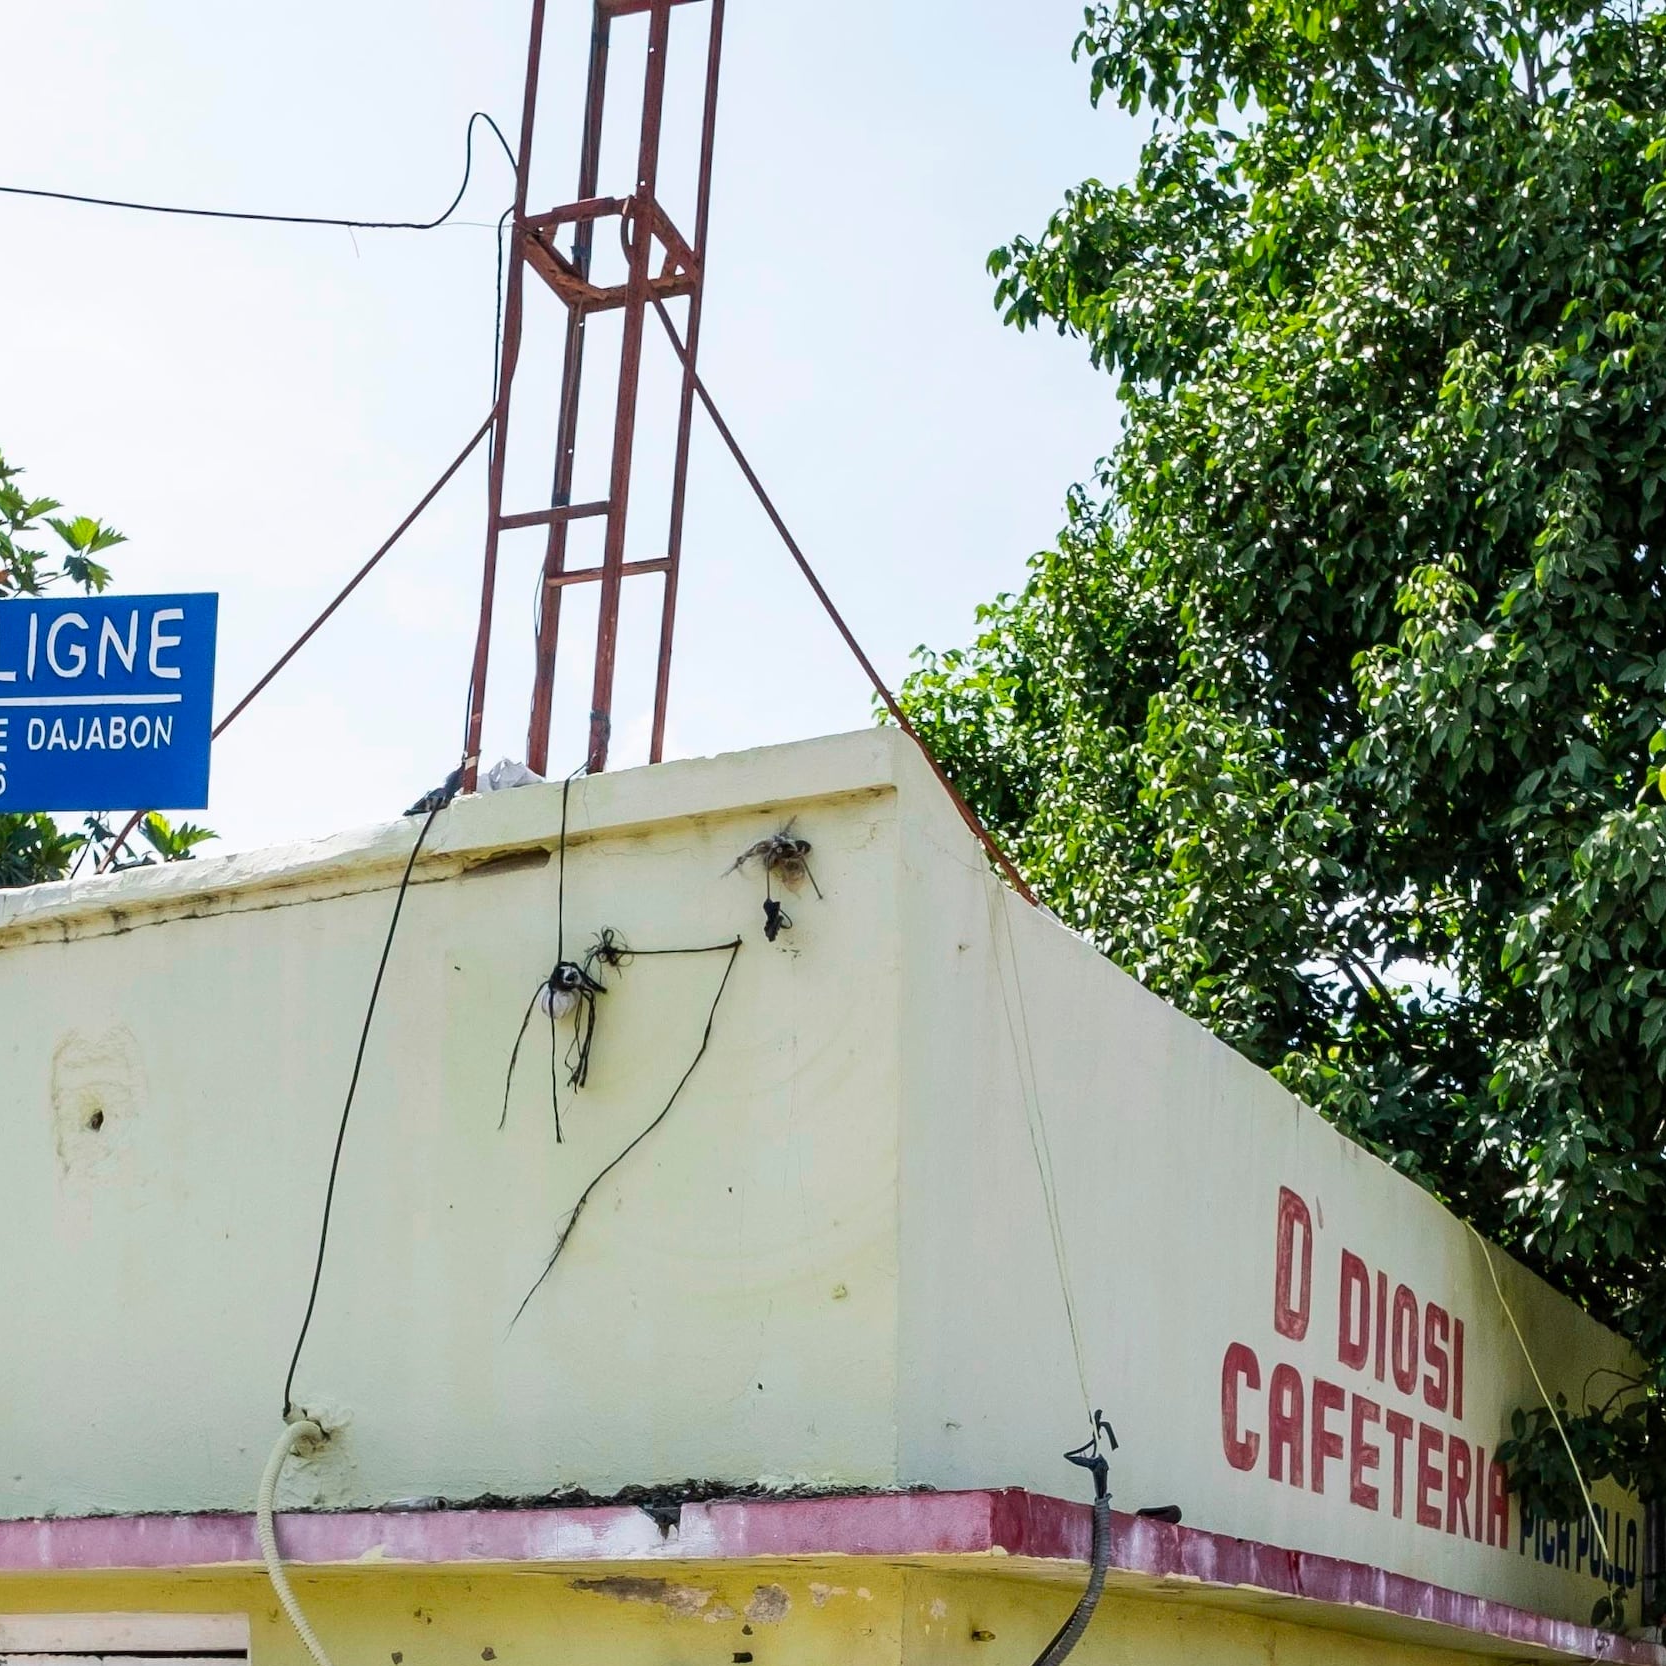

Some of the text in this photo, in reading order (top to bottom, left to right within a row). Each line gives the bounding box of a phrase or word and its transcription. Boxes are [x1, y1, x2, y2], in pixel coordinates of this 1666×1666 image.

[26, 714, 174, 753] DAJABON
[1338, 1247, 1464, 1421] DIOSI
[1221, 1341, 1509, 1550] CAFETERIA
